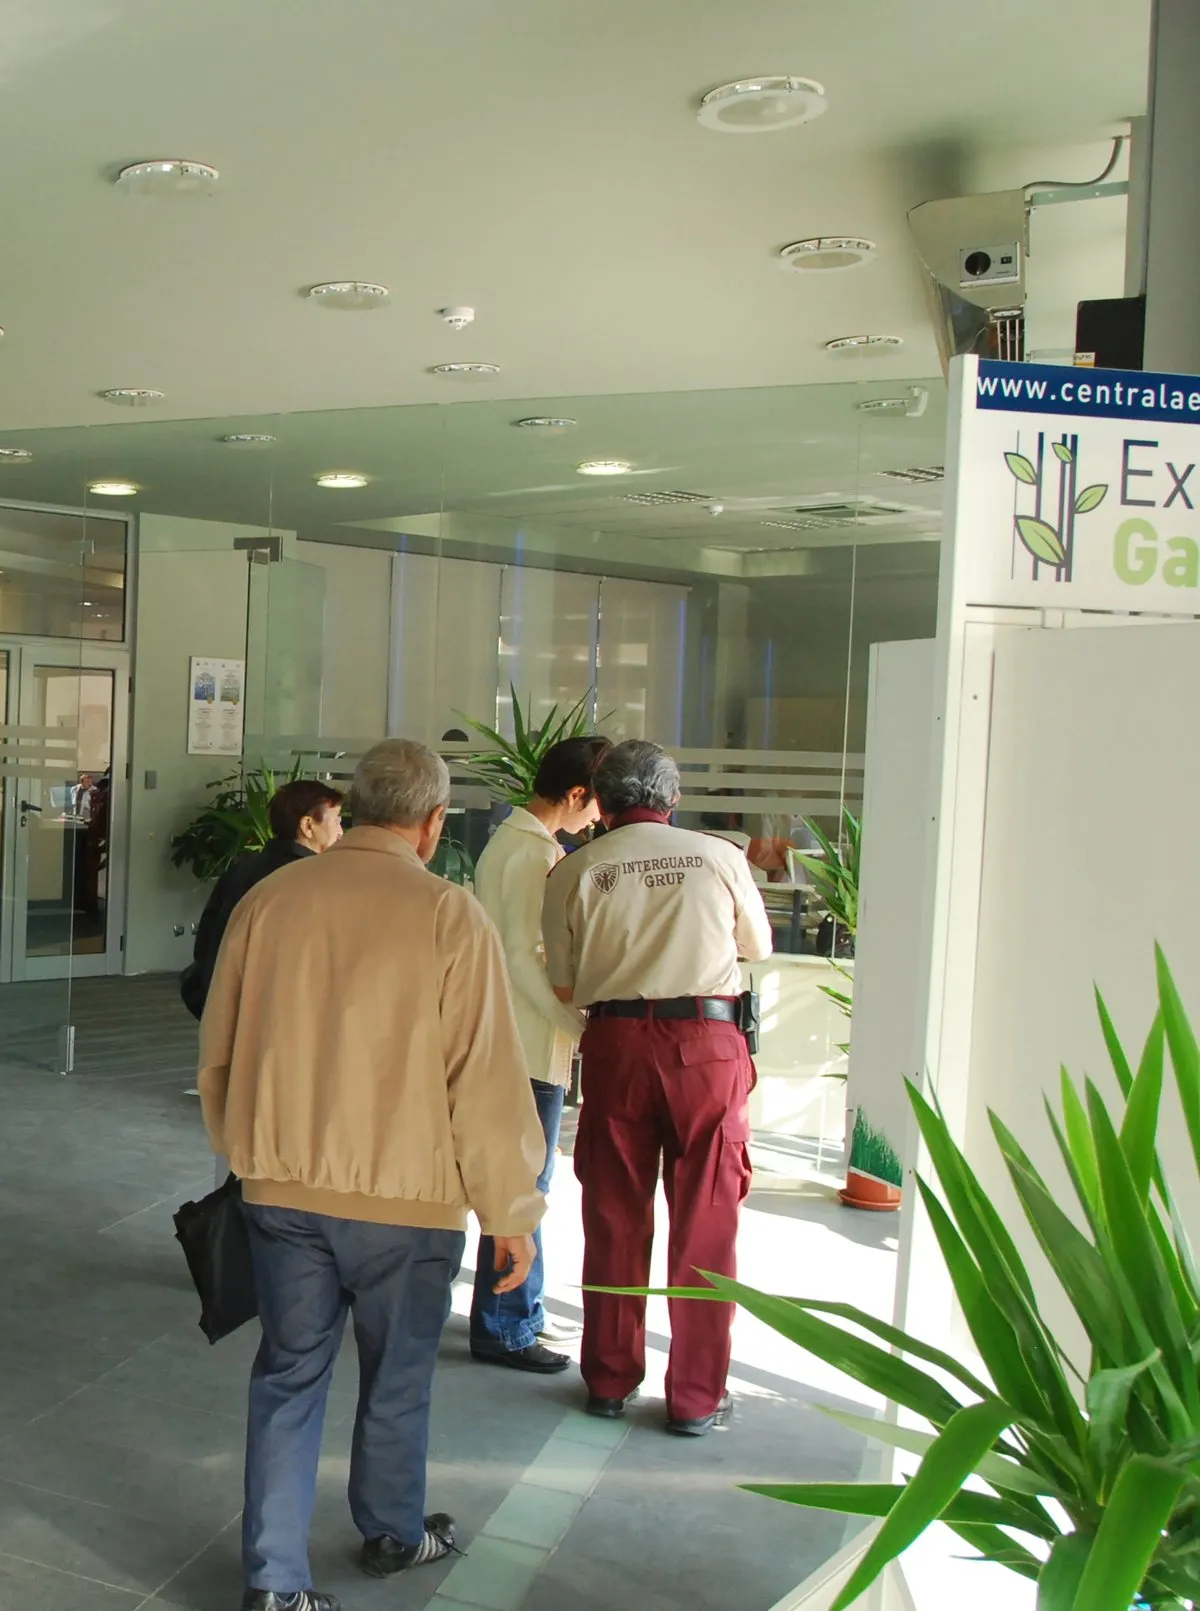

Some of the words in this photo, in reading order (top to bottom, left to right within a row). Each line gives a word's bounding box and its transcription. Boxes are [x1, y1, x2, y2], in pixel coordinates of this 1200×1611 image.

[977, 376, 1200, 411] www.centralae
[1120, 439, 1196, 510] Ex
[1113, 517, 1199, 588] Ga
[621, 856, 703, 874] INTERGUARD
[644, 872, 685, 888] GRUP
